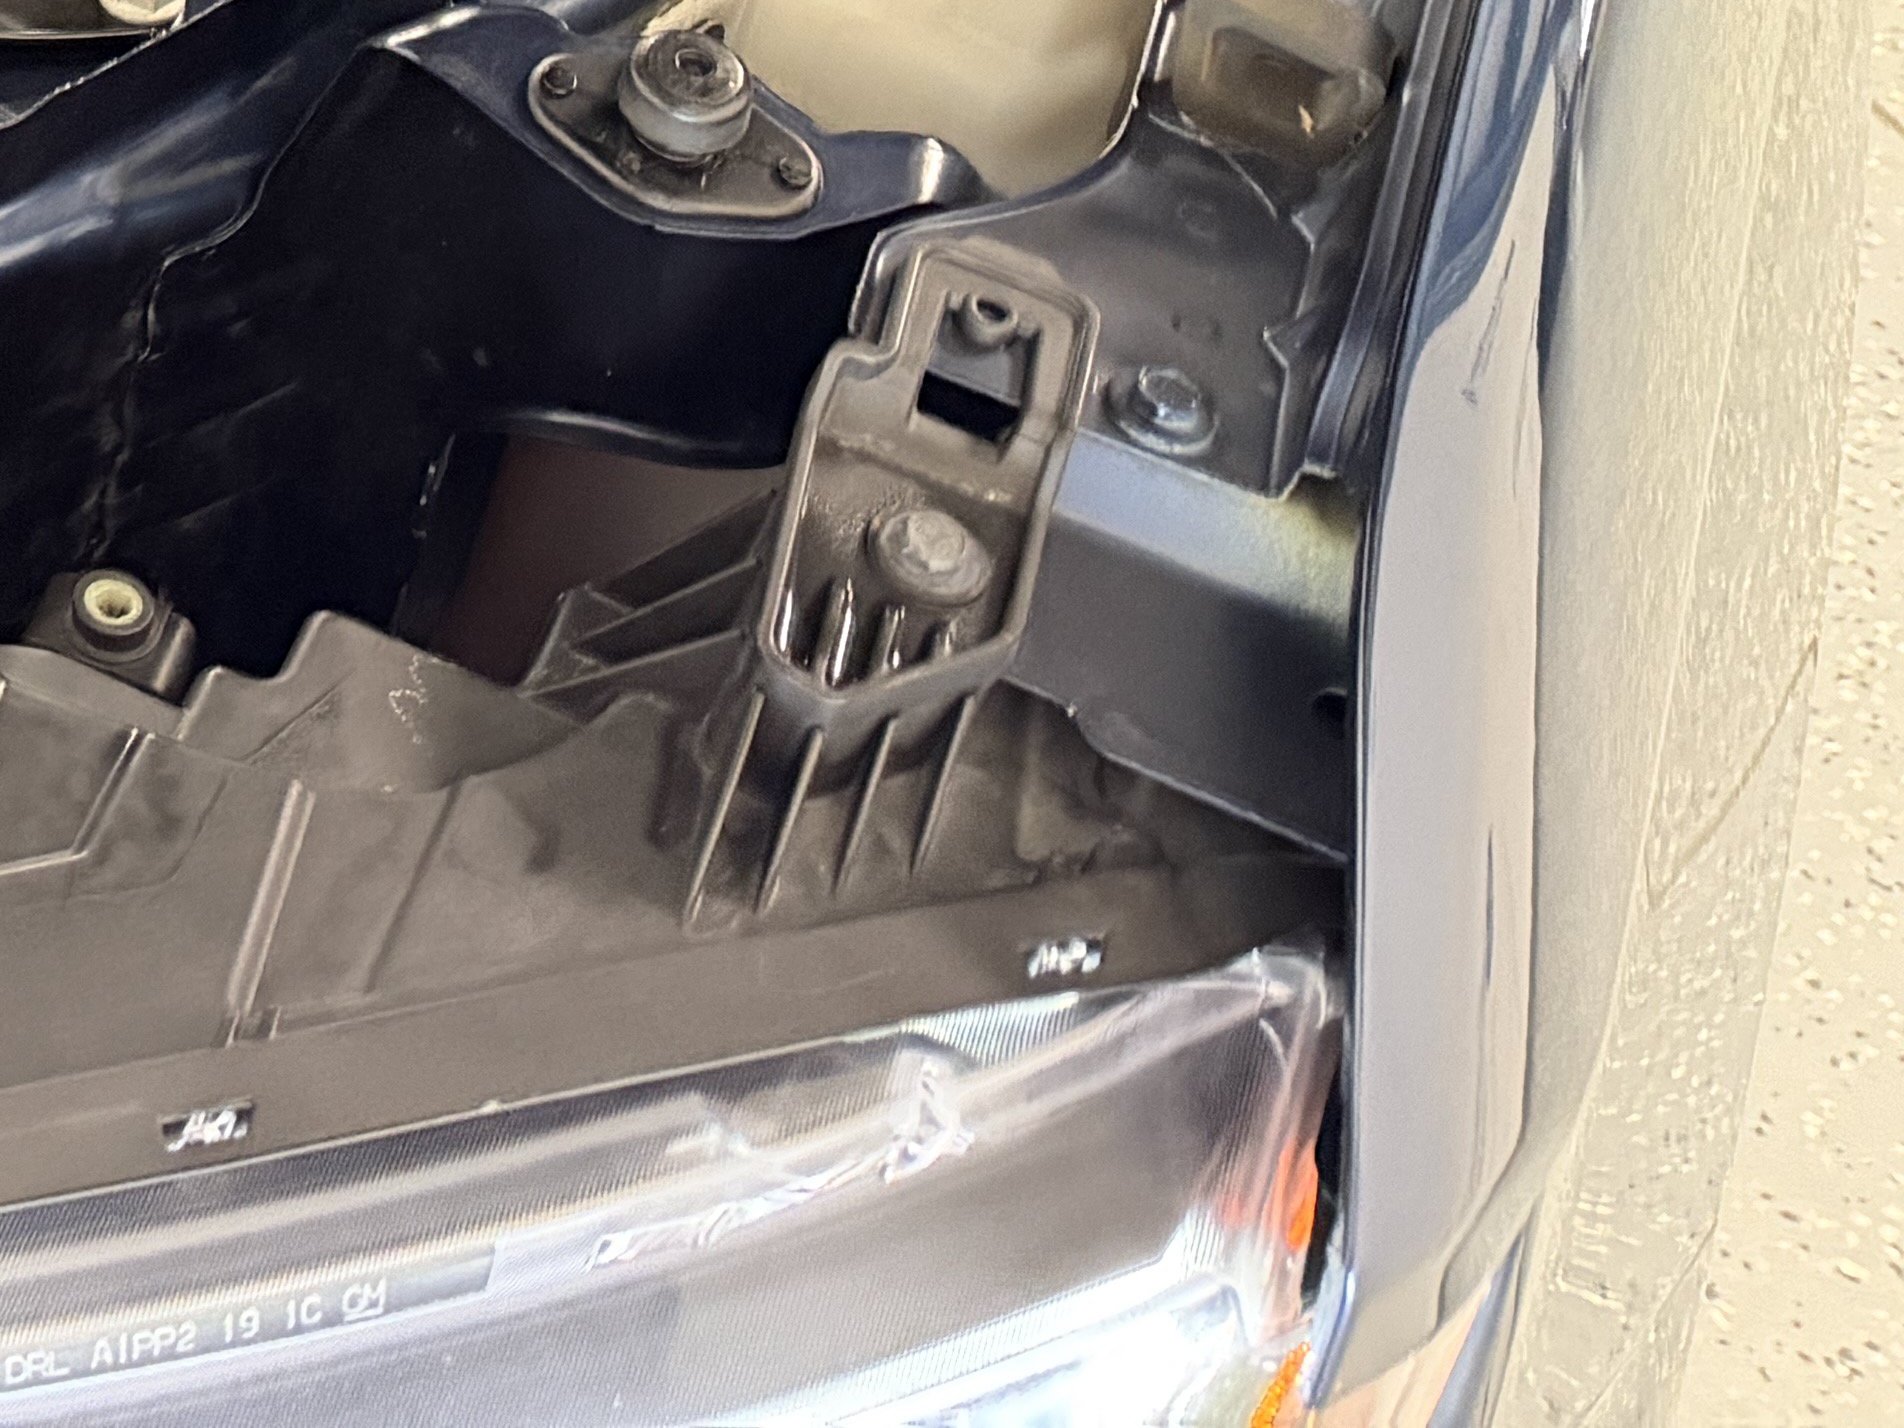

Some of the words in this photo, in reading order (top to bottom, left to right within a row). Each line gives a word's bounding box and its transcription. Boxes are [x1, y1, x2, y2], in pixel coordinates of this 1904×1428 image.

[4, 1350, 71, 1385] DRL
[223, 1304, 261, 1344] 19
[342, 1277, 387, 1322] GM
